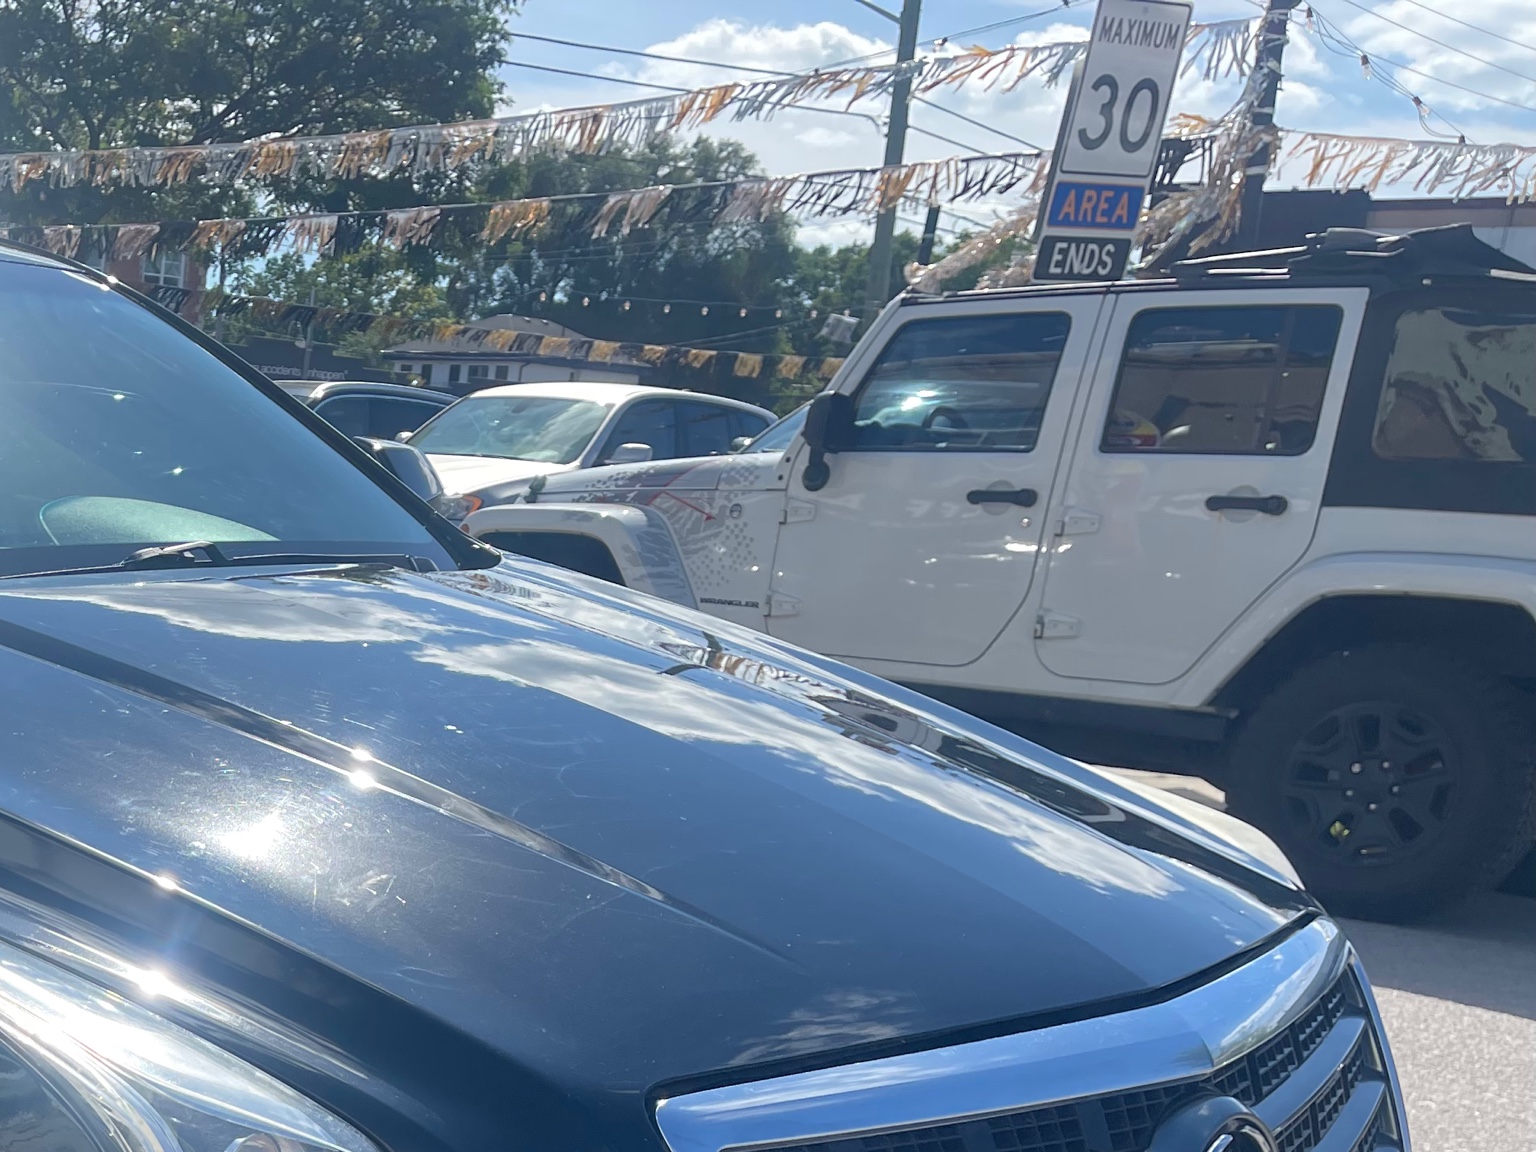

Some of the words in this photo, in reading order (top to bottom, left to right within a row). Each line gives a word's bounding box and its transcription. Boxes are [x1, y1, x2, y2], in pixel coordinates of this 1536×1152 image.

[1098, 16, 1181, 50] MAXIMUM
[1077, 74, 1160, 153] 30
[1058, 188, 1130, 224] AREA
[1048, 242, 1115, 276] ENDS
[261, 364, 302, 377] accidents
[700, 597, 760, 608] WRANGLER
